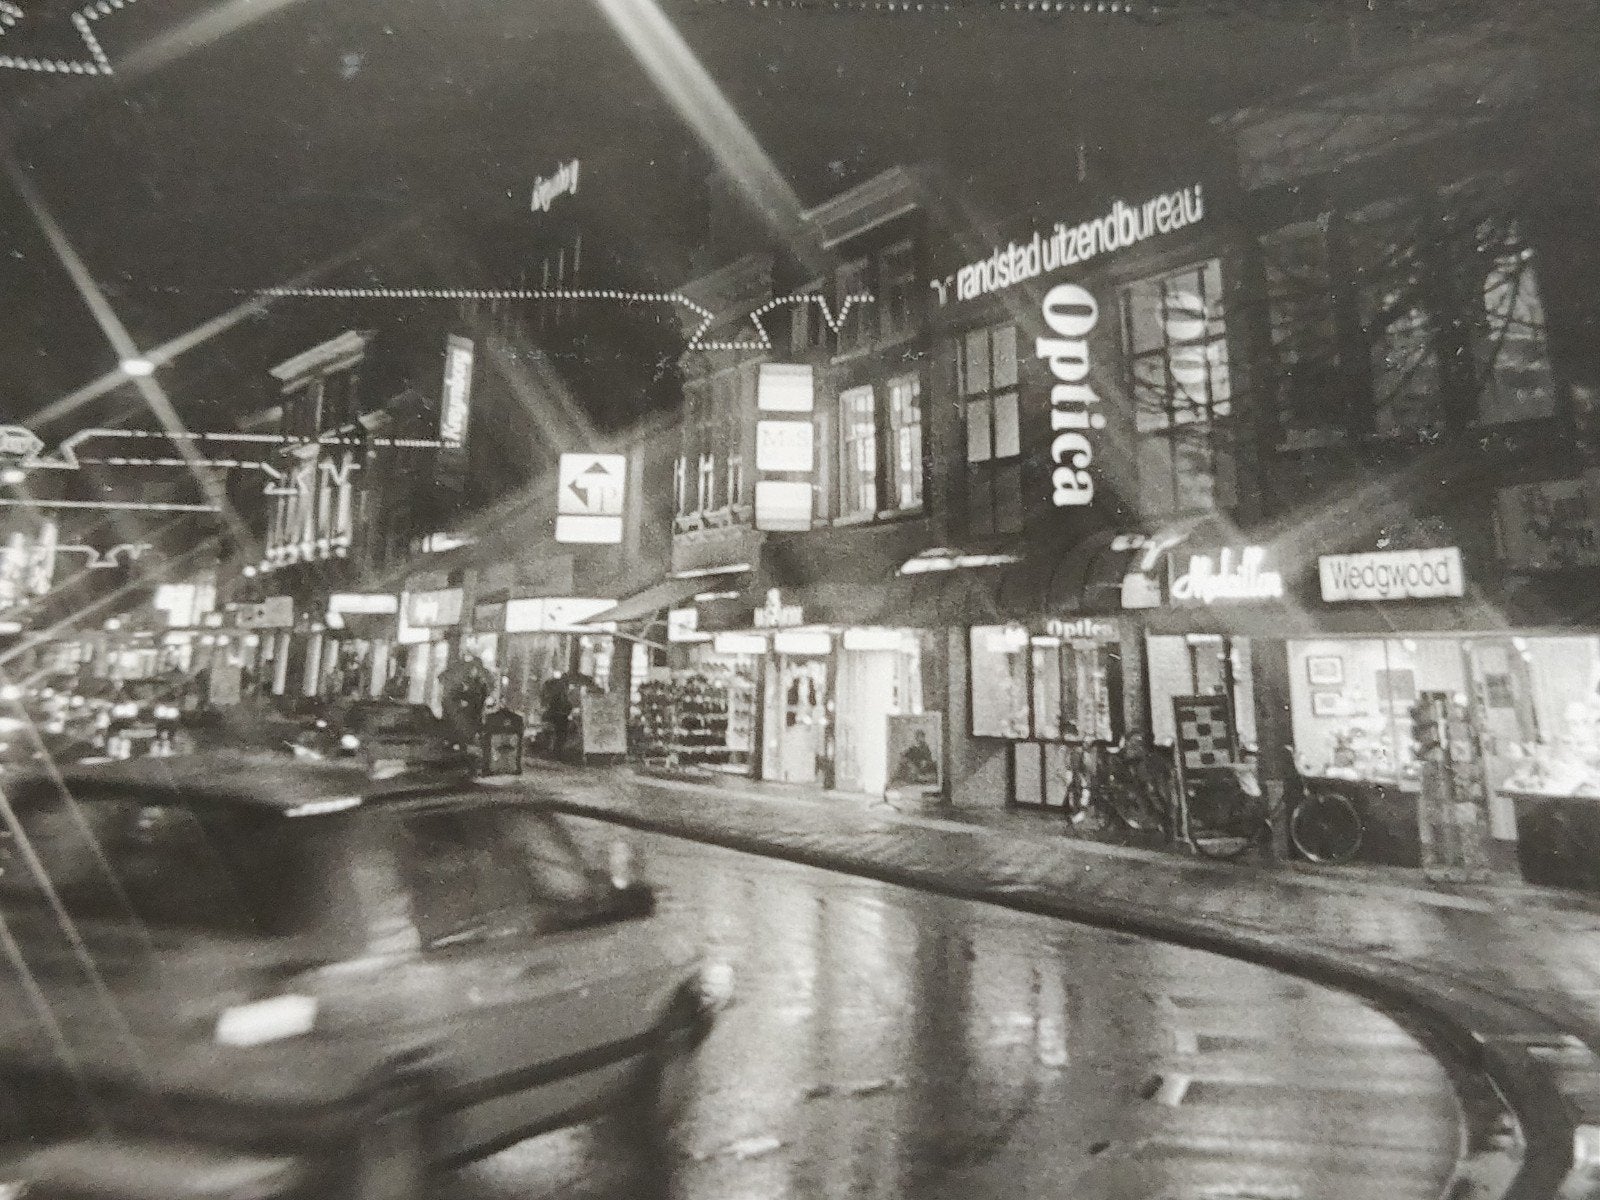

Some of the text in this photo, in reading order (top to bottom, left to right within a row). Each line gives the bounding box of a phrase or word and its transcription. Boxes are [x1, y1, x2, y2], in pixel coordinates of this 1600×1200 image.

[957, 183, 1202, 301] randstad uitzendbureau
[1036, 283, 1107, 507] Optica
[1329, 555, 1451, 597] Wedgwood
